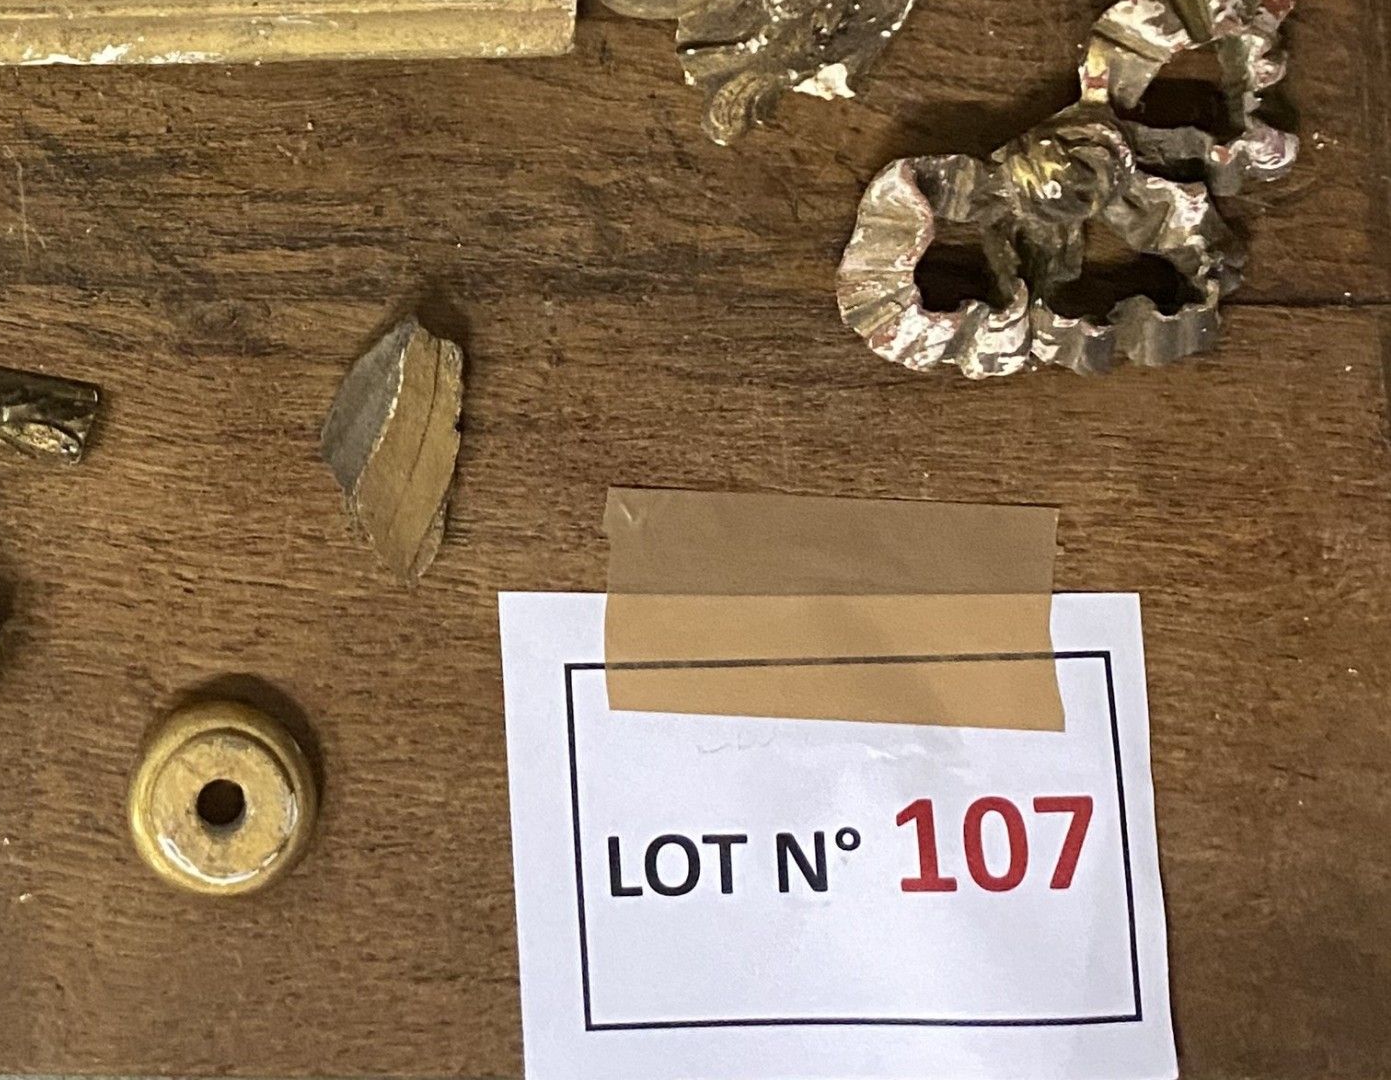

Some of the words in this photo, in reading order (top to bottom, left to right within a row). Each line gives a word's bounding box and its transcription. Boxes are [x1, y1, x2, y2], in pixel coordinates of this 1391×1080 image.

[607, 833, 748, 898] LOT
[774, 826, 862, 895] N°
[894, 794, 1095, 894] 107
